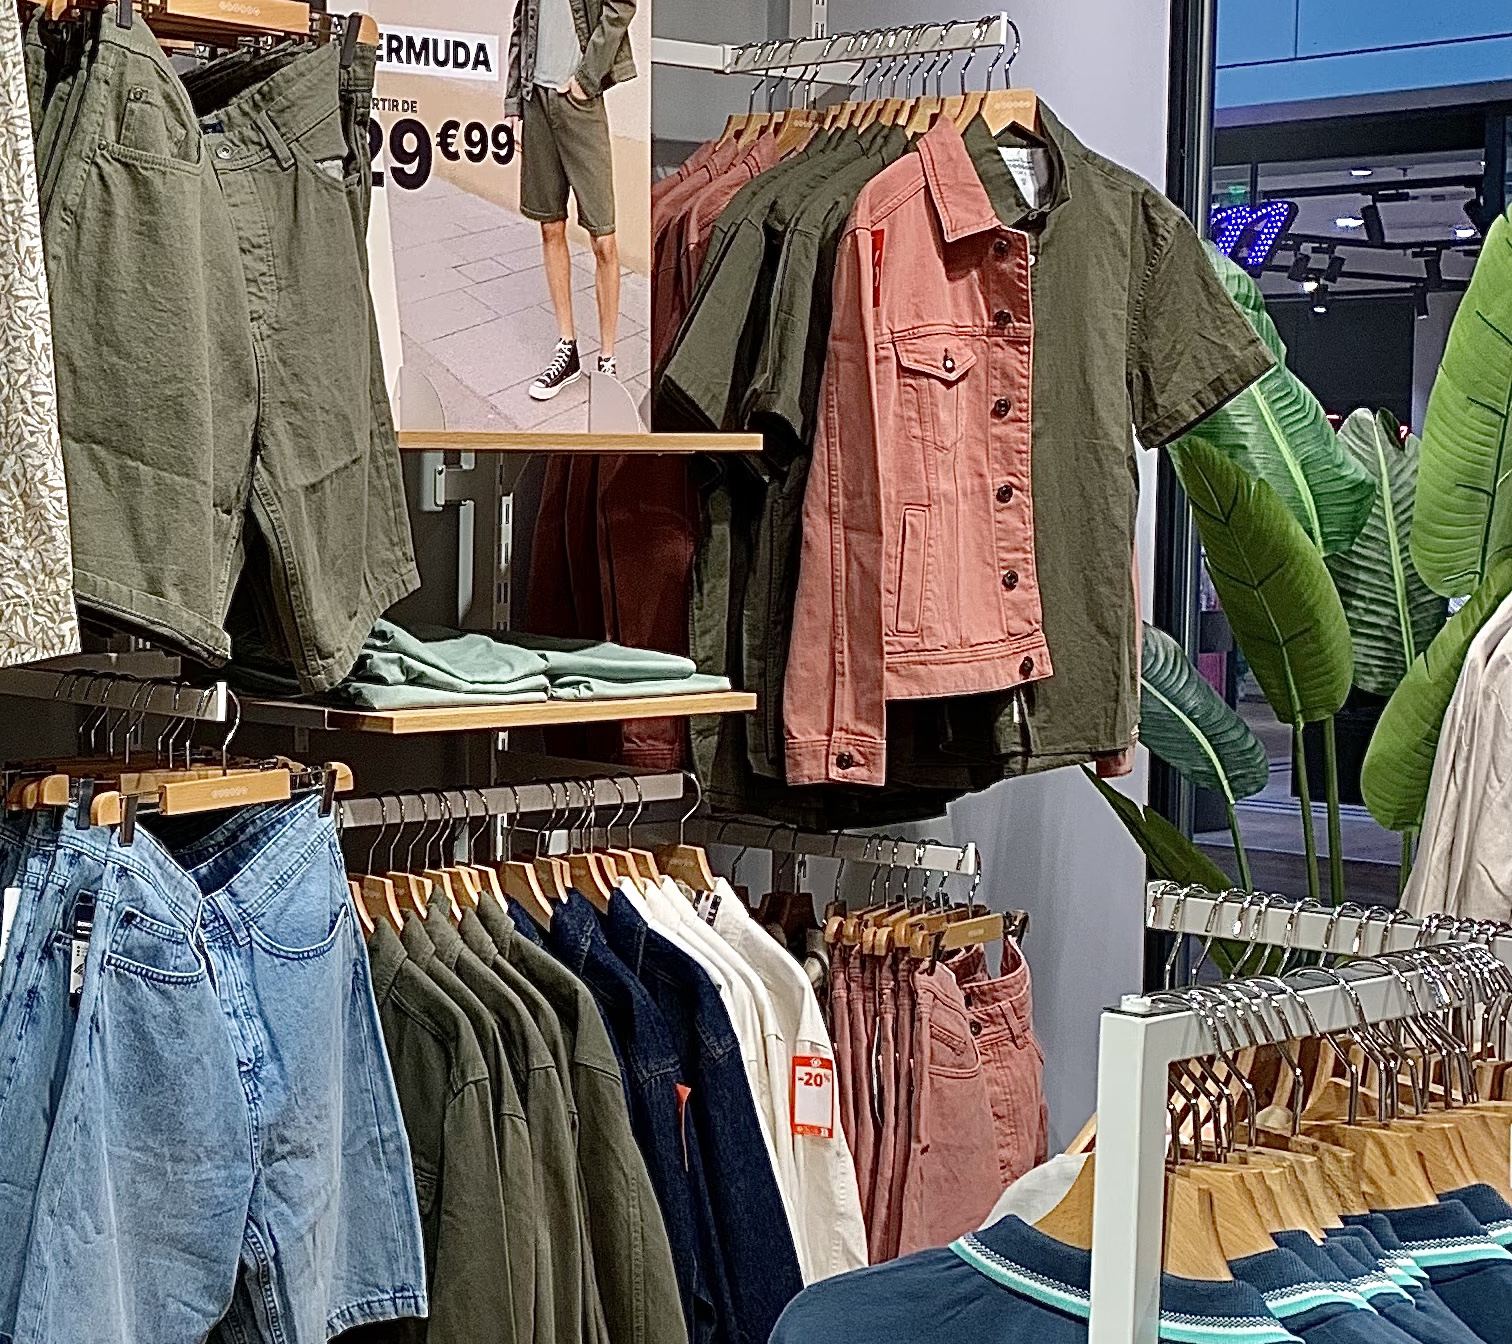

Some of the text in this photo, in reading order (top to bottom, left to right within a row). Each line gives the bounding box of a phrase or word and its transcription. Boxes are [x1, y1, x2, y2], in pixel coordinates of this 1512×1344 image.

[376, 33, 492, 73] RMUDA
[372, 97, 418, 114] RTIR DE
